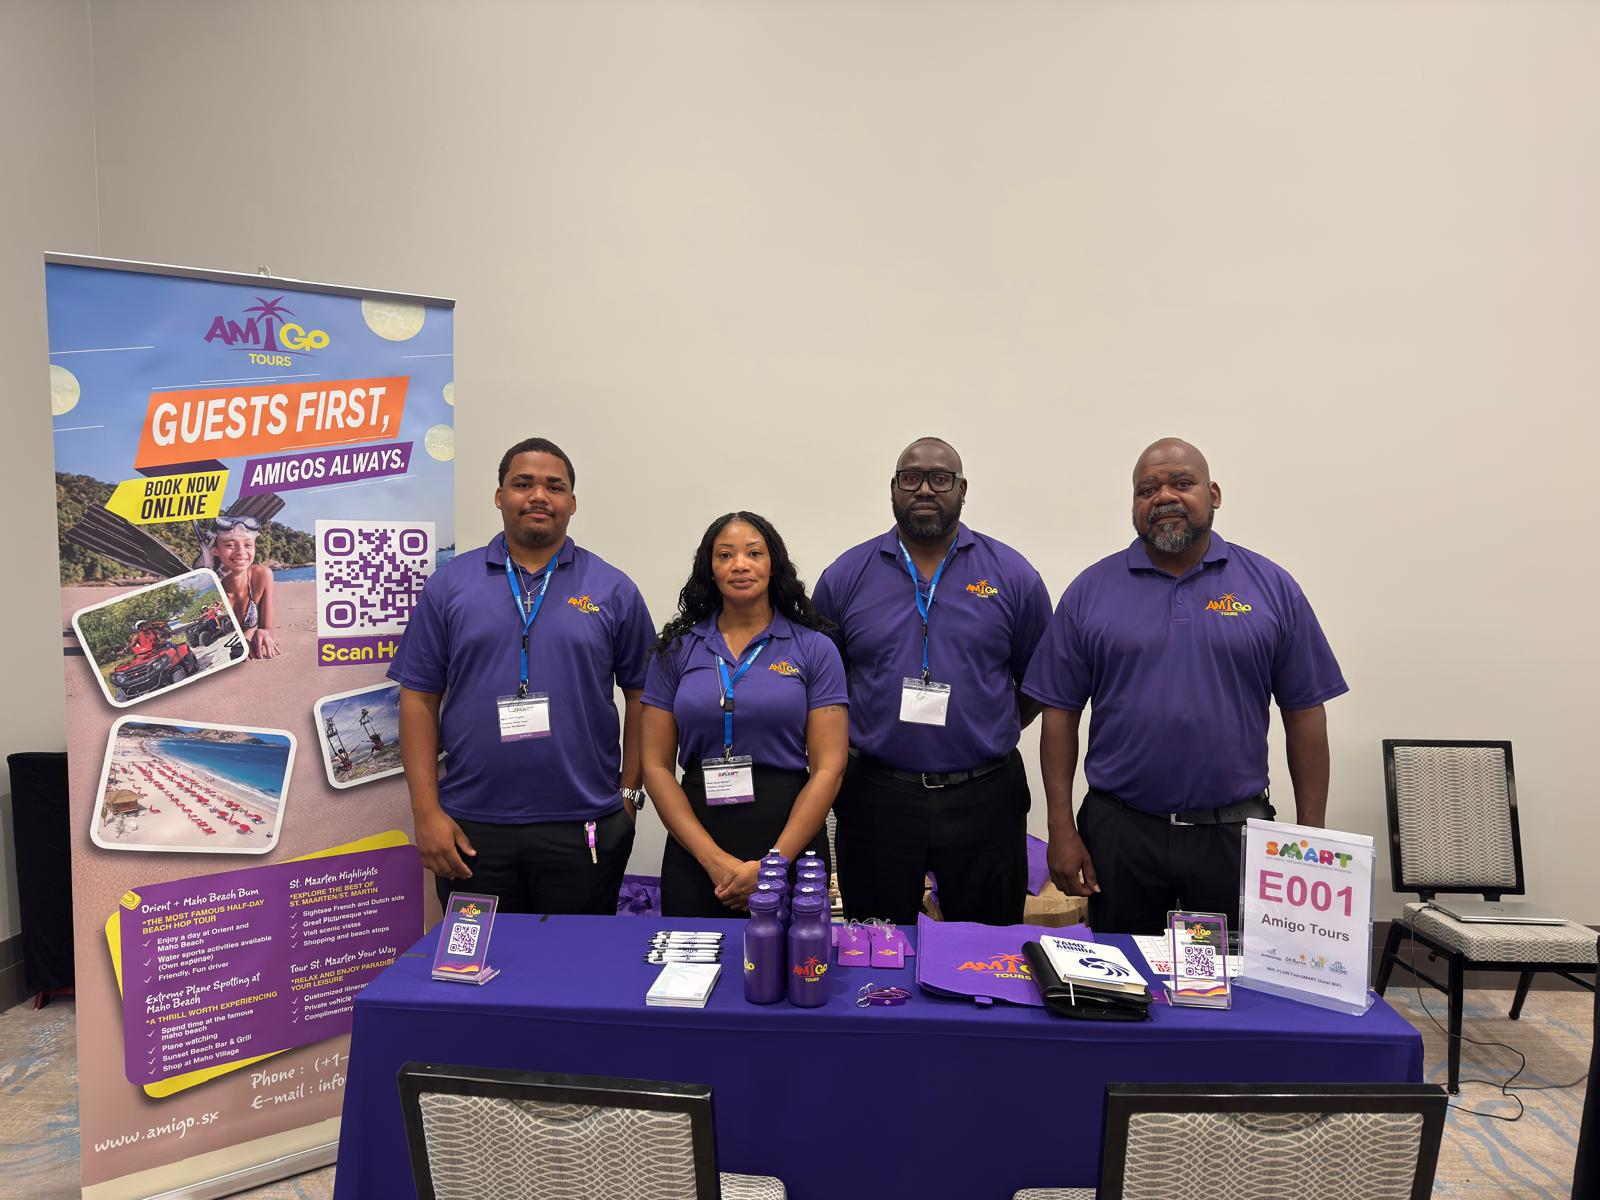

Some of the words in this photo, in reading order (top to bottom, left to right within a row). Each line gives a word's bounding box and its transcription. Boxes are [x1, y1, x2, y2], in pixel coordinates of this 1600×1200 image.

[248, 354, 292, 367] TOURS
[152, 393, 288, 446] GUESTS
[296, 386, 389, 432] FIRST,
[250, 456, 326, 486] AMIGOS
[329, 449, 404, 476] ALWAYS.
[144, 478, 182, 497] BOOK
[186, 476, 220, 494] NOW
[141, 494, 208, 520] ONLINE
[322, 644, 374, 662] Scan
[1266, 840, 1352, 868] SMART
[290, 878, 302, 888] St.
[304, 874, 337, 886] Maarten
[339, 867, 378, 883] Highlights
[142, 901, 171, 914] Orient
[184, 895, 206, 906] Maho
[209, 890, 236, 902] Beach
[238, 888, 259, 898] Bum
[351, 888, 378, 896] MARTIN
[1259, 870, 1352, 918] E001
[166, 912, 188, 922] MOST
[191, 906, 225, 917] FAMOUS
[227, 900, 264, 912] HALF-DAY
[303, 907, 332, 916] Sightsee
[334, 904, 356, 912] French
[324, 912, 362, 924] Picturesque
[142, 924, 172, 934] BEACH
[174, 920, 192, 929] HOP
[194, 915, 216, 925] TOUR
[320, 926, 341, 934] scenic
[1261, 914, 1305, 933] Amigo
[1310, 924, 1350, 942] Tours
[157, 936, 178, 945] Enjoy
[187, 932, 200, 940] day
[212, 926, 234, 935] Orient
[181, 939, 204, 947] Beach
[303, 936, 336, 946] Shopping
[158, 954, 179, 963] Water
[182, 949, 205, 958] sports
[207, 942, 239, 953] activities
[241, 935, 272, 946] available
[158, 963, 178, 972] (Own
[180, 954, 214, 966] expense)
[208, 962, 229, 970] driver
[290, 964, 308, 973] Tour
[310, 959, 322, 969] St.
[325, 953, 356, 966] Maarten
[358, 950, 376, 959] Your
[379, 946, 397, 956] Way
[957, 953, 1031, 974] AMI
[336, 966, 360, 975] ENJOY
[145, 990, 184, 1004] Extreme
[186, 984, 211, 994] Plane
[213, 977, 250, 992] Spotting
[252, 972, 261, 981] at
[291, 983, 312, 991] YOUR
[313, 976, 344, 987] LEISURE
[146, 1003, 170, 1014] Maho
[173, 994, 200, 1008] Beach
[304, 988, 343, 1001] Customized
[304, 1002, 327, 1011] Private
[328, 996, 352, 1006] vehicle
[158, 1012, 187, 1022] THRILL
[189, 1005, 218, 1016] WORTH
[220, 991, 278, 1010] EXPERIENCING
[304, 1006, 353, 1020] Complimentary
[161, 1025, 186, 1035] Spend
[188, 1020, 204, 1028] time
[228, 1009, 254, 1019] famous
[161, 1032, 183, 1040] maho
[185, 1026, 207, 1035] beach
[162, 1042, 184, 1051] Plane
[185, 1034, 218, 1046] watching
[163, 1052, 189, 1061] Sunset
[191, 1045, 213, 1054] Beach
[237, 1034, 252, 1043] Grill
[163, 1063, 182, 1072] Shop
[194, 1055, 213, 1064] Maho
[216, 1049, 240, 1058] Village
[250, 1069, 295, 1089] Phone
[250, 1082, 304, 1109] E-mail
[94, 1110, 219, 1153] www.amigo.sx
